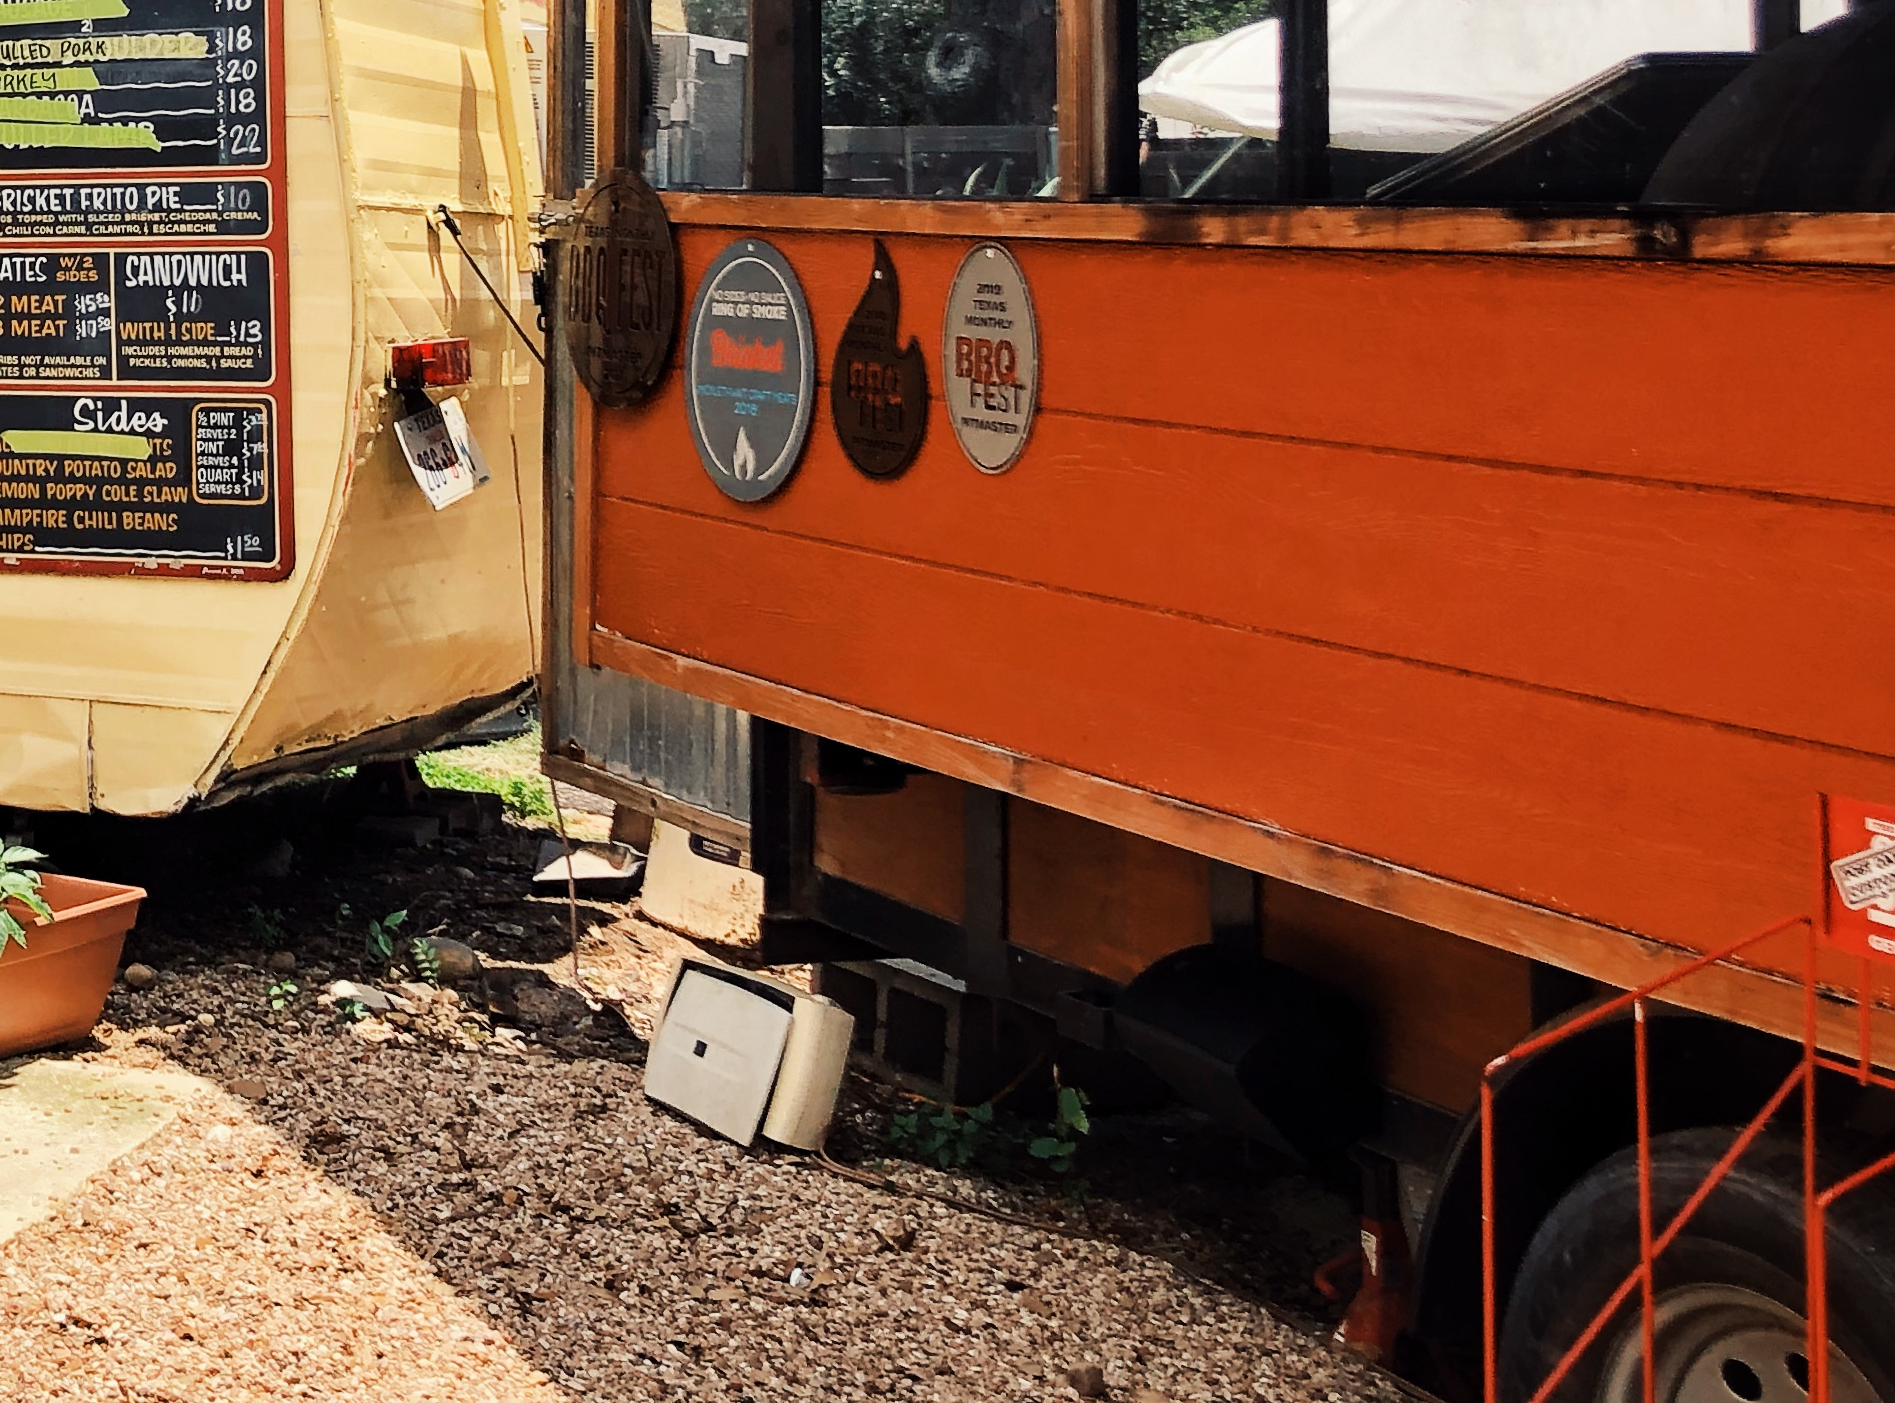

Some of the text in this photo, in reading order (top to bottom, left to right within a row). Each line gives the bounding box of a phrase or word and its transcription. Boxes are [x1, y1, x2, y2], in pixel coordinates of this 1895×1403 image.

[60, 40, 107, 58] PORK
[79, 186, 139, 212] FRITO
[145, 185, 182, 210] PIE
[17, 214, 55, 223] TOPPED
[58, 214, 85, 222] WITH
[87, 213, 121, 222] SLICED
[5, 226, 32, 235] CHILI
[33, 226, 54, 235] CON
[56, 270, 99, 282] SIDES
[125, 254, 248, 287] SANDWICH
[976, 283, 1003, 295] 2019
[10, 294, 67, 314] MEAT
[711, 302, 788, 320] RING OF SMOKE
[972, 299, 1007, 313] TEXAS
[10, 319, 68, 338] MEAT
[963, 314, 1014, 330] MONTHLY
[119, 321, 165, 341] WITH
[181, 322, 216, 341] SIDE
[121, 345, 166, 356] INCLUDES
[167, 346, 221, 356] HOMEMADE
[223, 346, 254, 356] BREAD
[20, 355, 42, 365] NOT
[43, 355, 92, 365] AVAILABLE
[93, 356, 107, 366] ON
[220, 358, 255, 369] SAUCE
[955, 335, 1018, 387] BBQ
[22, 367, 37, 377] OR
[38, 367, 101, 378] SANDWICHES
[969, 377, 1027, 415] FEST
[73, 397, 169, 433] Sides
[209, 412, 235, 427] PINT
[196, 428, 237, 439] SERVES 2
[196, 441, 225, 455] PINT
[196, 456, 239, 467] SERVES 4
[63, 460, 121, 478] POTATO
[126, 461, 177, 479] SALAD
[197, 468, 239, 483] QUART
[46, 483, 97, 501] POPPY
[102, 484, 138, 502] COLE
[143, 485, 189, 503] SLAW
[198, 483, 242, 494] SERVES 8
[73, 510, 117, 530] CHILI
[122, 511, 179, 532] BEANS
